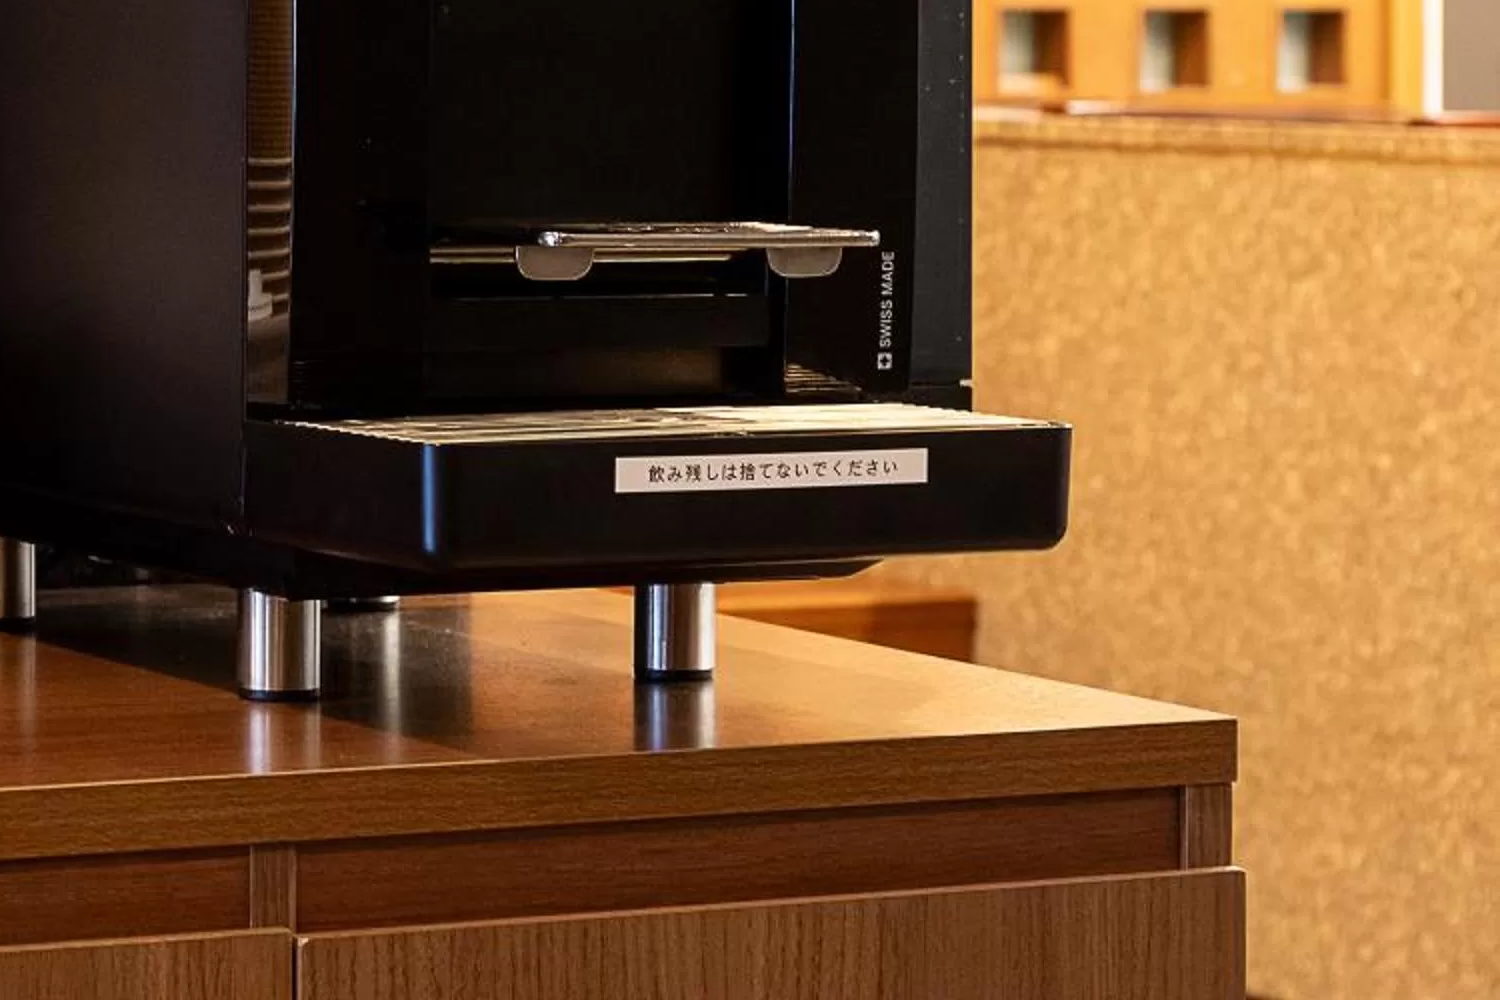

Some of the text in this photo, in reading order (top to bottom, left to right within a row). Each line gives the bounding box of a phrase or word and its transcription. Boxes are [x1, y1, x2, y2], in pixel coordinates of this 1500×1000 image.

[879, 251, 895, 348] SWISS MADE
[648, 458, 899, 483] 飲み残しは捨てないでください
